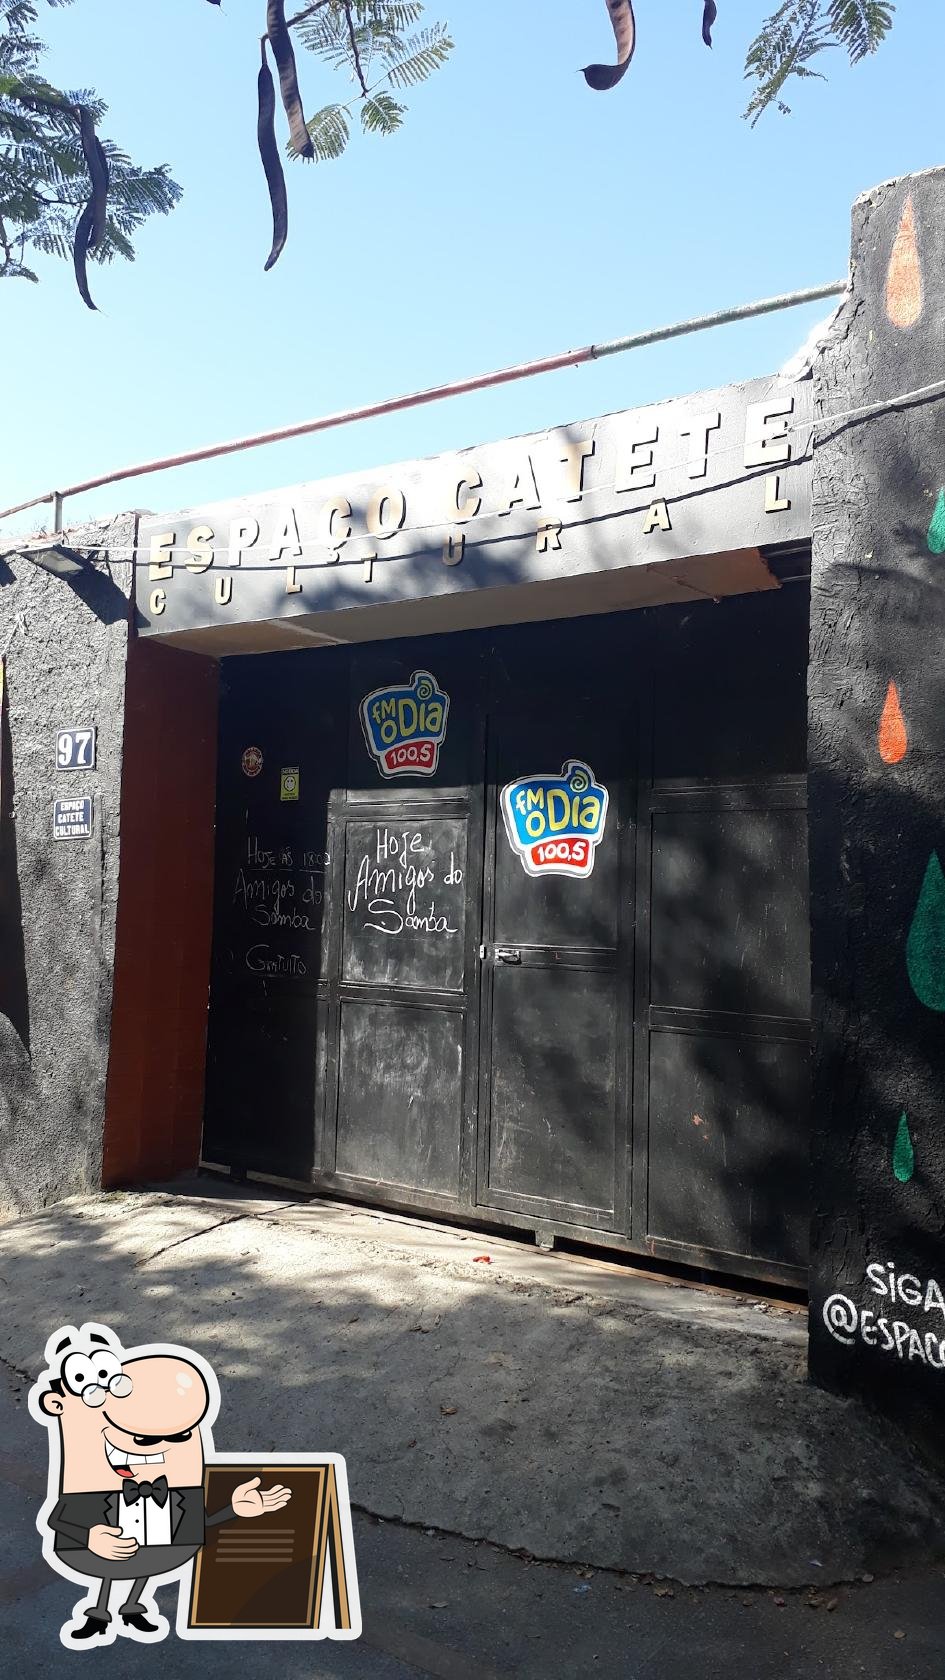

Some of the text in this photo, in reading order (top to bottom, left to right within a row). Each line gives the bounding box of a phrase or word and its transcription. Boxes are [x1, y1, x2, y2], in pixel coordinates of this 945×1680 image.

[149, 396, 795, 581] ESPAÇO CATETE
[150, 475, 792, 615] CULTURAL
[58, 731, 91, 767] 97
[390, 743, 432, 766] 100,5
[57, 811, 85, 823] CATETE
[537, 841, 587, 864] 100,5
[302, 875, 323, 905] do
[348, 851, 463, 916] Amigos do
[249, 904, 317, 931] Samba
[363, 898, 458, 935] Samba
